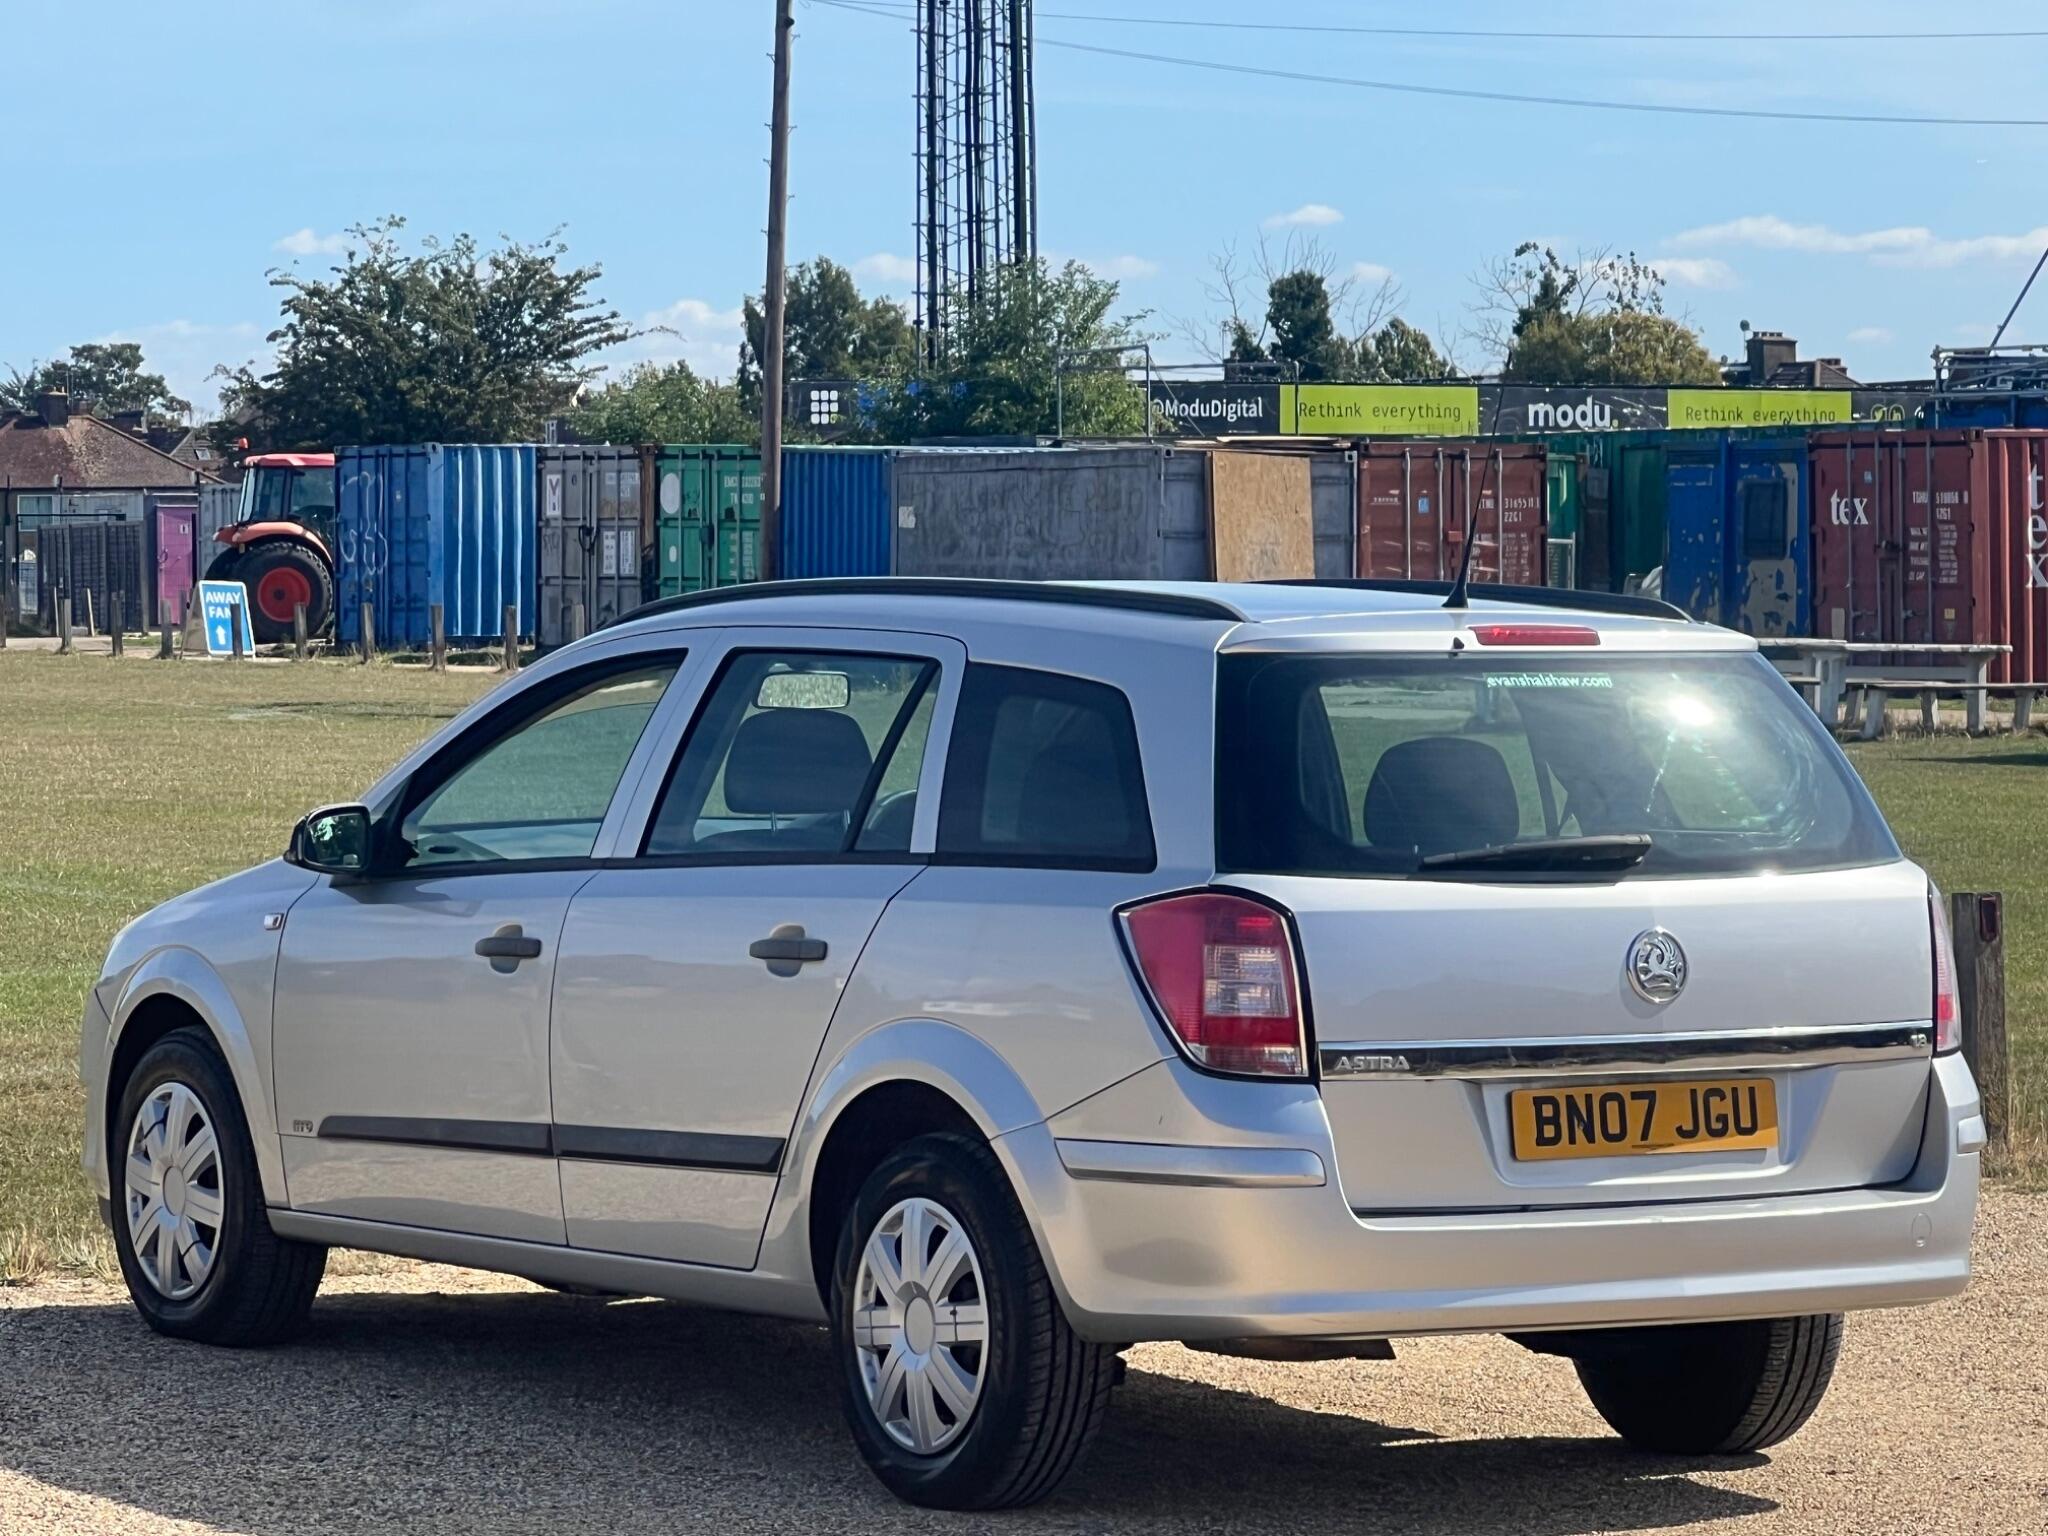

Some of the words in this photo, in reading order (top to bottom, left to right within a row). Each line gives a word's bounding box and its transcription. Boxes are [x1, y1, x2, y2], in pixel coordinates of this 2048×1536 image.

[1299, 402, 1362, 418] Rethink
[1373, 403, 1461, 423] everything
[1686, 406, 1744, 422] Rethink
[1753, 408, 1836, 424] everything
[1830, 489, 1869, 525] tex
[205, 591, 241, 604] AWAY
[1487, 673, 1613, 688] evanshalshaw.com
[1334, 1055, 1410, 1071] ASTRA
[1533, 1090, 1657, 1147] BN07
[1675, 1086, 1759, 1139] JGU
